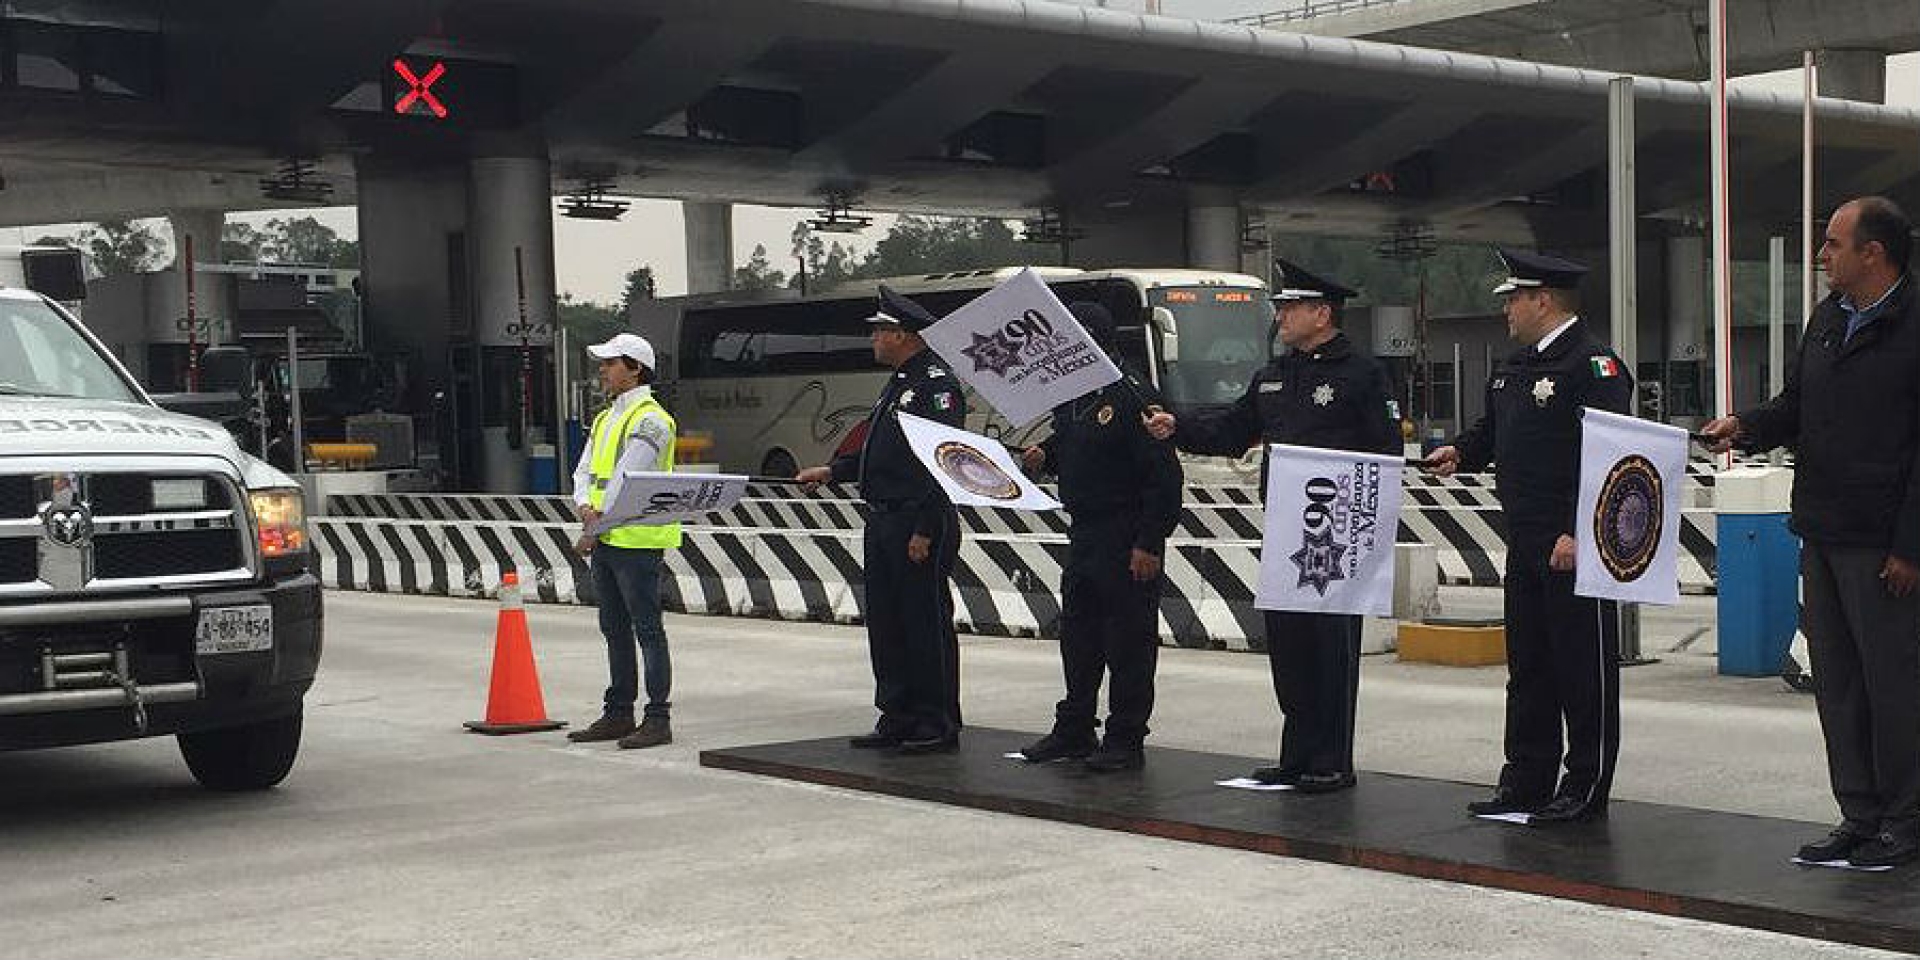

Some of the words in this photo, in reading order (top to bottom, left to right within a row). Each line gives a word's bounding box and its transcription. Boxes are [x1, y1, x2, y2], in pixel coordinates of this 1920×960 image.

[1005, 308, 1053, 346] 90
[1303, 477, 1338, 529] 90
[1347, 462, 1364, 545] confianza
[1357, 462, 1379, 536] México
